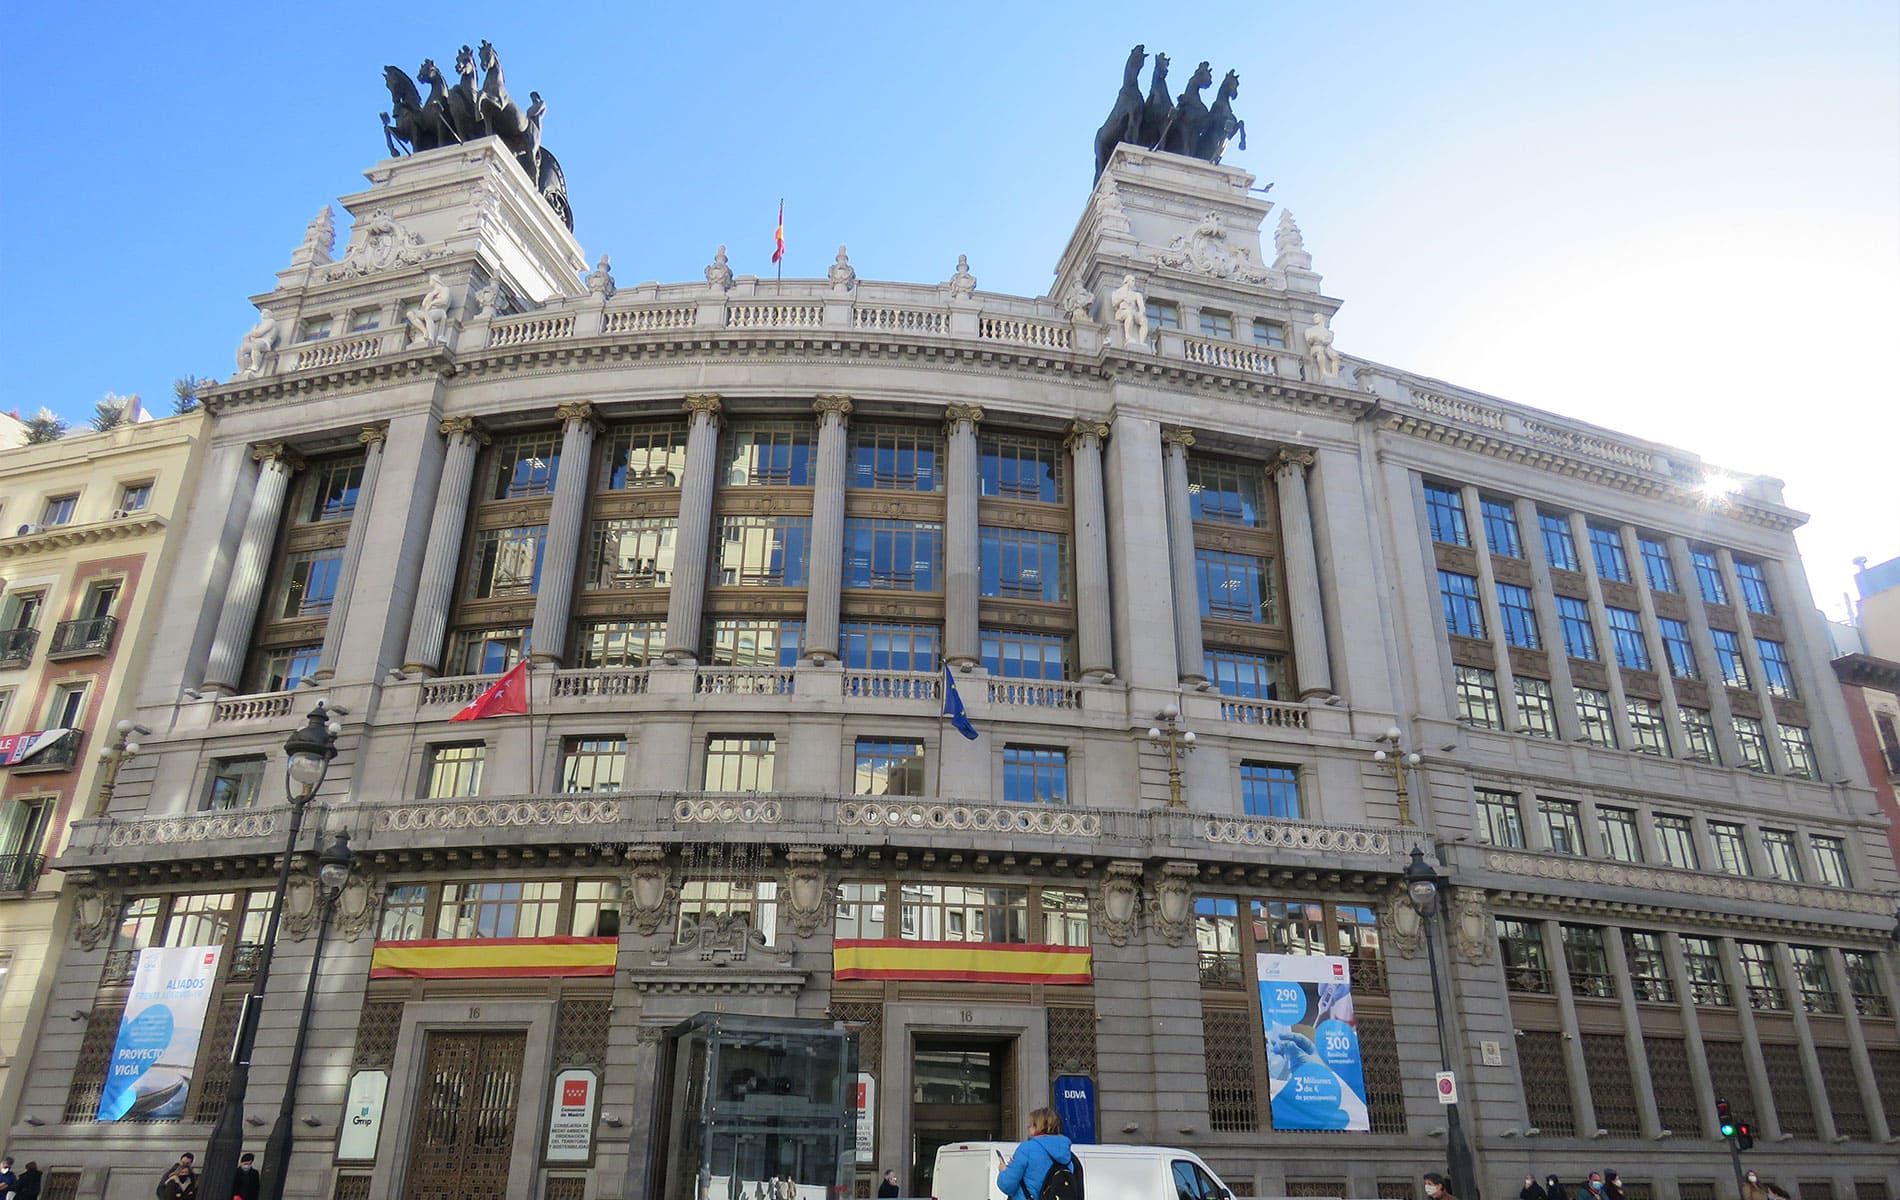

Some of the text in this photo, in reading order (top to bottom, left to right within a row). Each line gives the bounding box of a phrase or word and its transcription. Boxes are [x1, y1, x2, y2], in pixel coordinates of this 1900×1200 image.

[166, 978, 205, 990] ALIADOS
[1275, 988, 1298, 1001] 290
[469, 1007, 480, 1019] 16
[960, 1010, 973, 1023] 16
[1325, 1037, 1350, 1050] 300
[118, 1048, 164, 1060] PROYECTO
[114, 1062, 139, 1076] VIGÍA
[1294, 1076, 1303, 1092] 3
[1064, 1090, 1087, 1099] BBVA
[352, 1115, 372, 1127] Gmp
